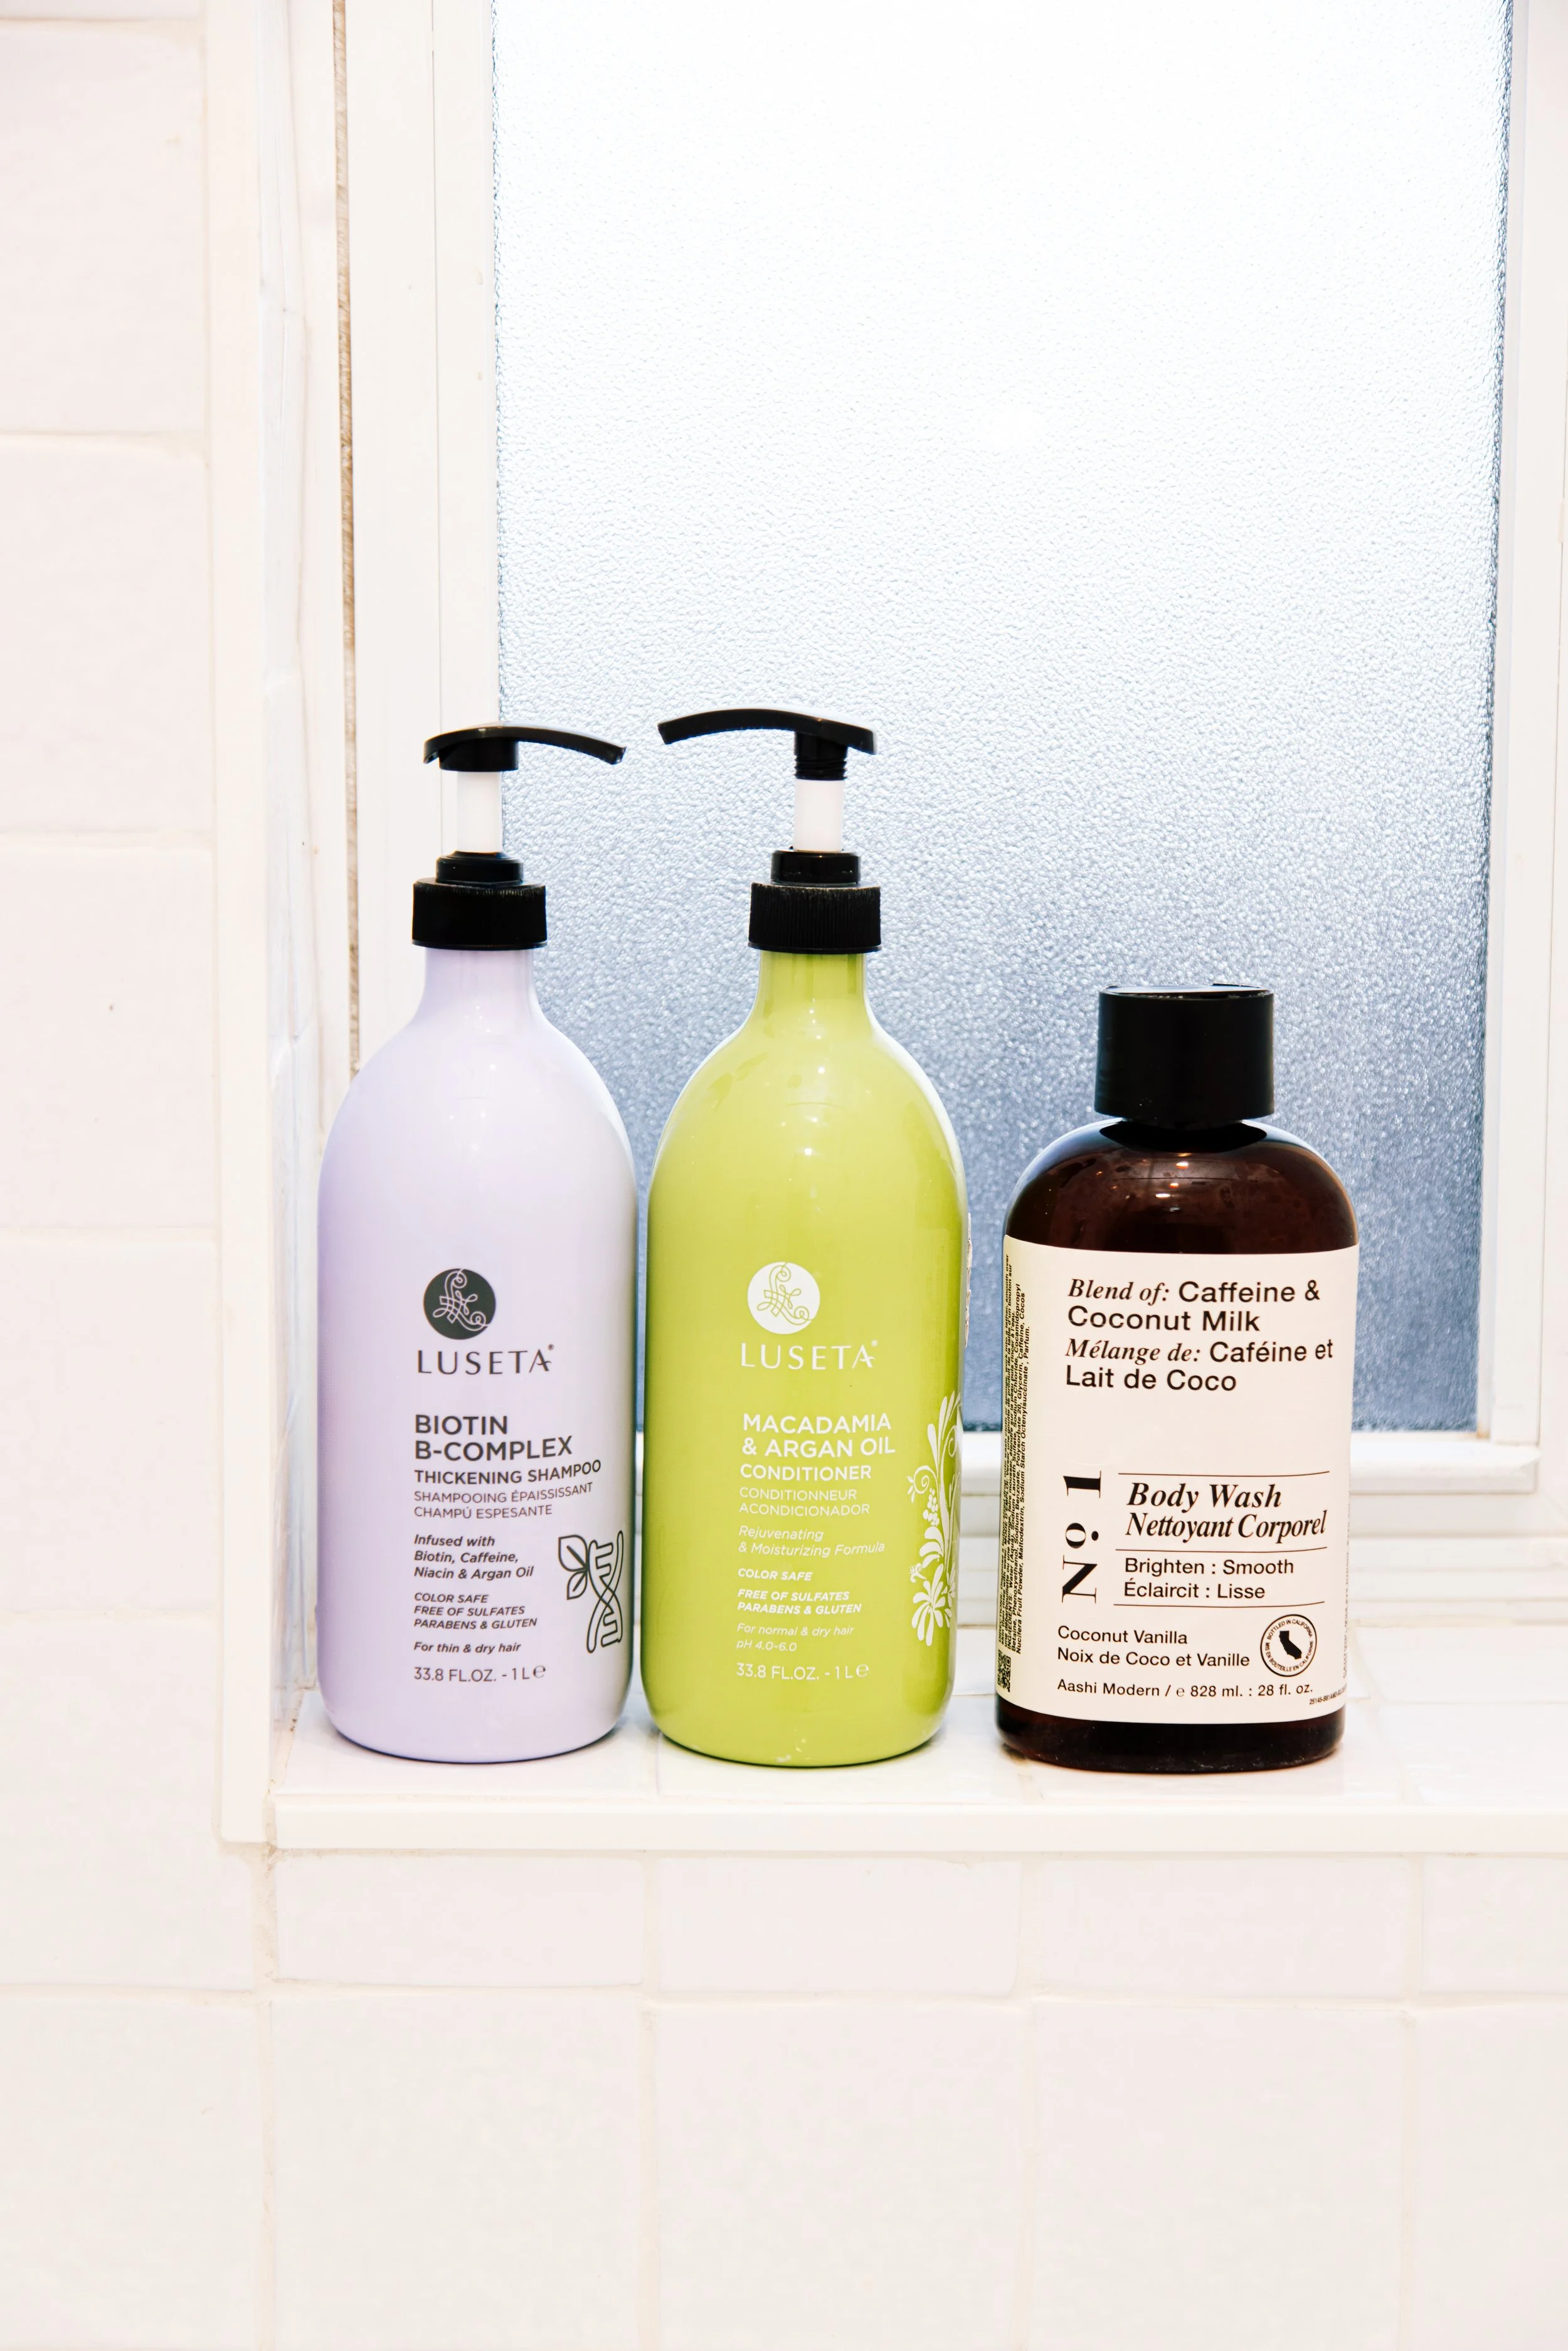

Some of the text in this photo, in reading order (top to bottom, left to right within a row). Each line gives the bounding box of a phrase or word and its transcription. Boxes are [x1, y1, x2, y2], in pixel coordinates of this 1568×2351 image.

[1067, 1278, 1320, 1306] Blend of: Caffeine &
[1068, 1305, 1260, 1332] Coconut Milk
[1065, 1338, 1333, 1366] Mélange de: Caféine et
[1066, 1364, 1237, 1391] Lait de Coco
[415, 1414, 507, 1435] BIOTIN
[743, 1413, 892, 1435] MACADAMIA
[415, 1435, 572, 1462] B-COMPLEX
[742, 1436, 896, 1458] & ARGAN OIL
[414, 1459, 601, 1485] THICKENING SHAMPOO
[739, 1463, 872, 1482] CONDITIONER
[414, 1482, 593, 1504] SHAMPOOING ÉPAISSISSANT
[739, 1487, 857, 1501] CONDITIONNEUR
[1126, 1482, 1281, 1514] Body Wash
[413, 1504, 553, 1519] CHAMPÚ ESPESANTE
[739, 1502, 870, 1517] ACONDICIONADOR
[738, 1525, 824, 1542] Rejuvenating
[1125, 1509, 1327, 1544] Nettoyant Corporel
[414, 1534, 495, 1547] Infused with
[413, 1550, 518, 1564] Biotin, Caffeine,
[738, 1541, 885, 1559] & Moisturizing Formula
[413, 1566, 534, 1581] Niacin & Argan Oil
[738, 1568, 813, 1581] COLOR SAFE
[1125, 1558, 1204, 1578] Brighten
[1222, 1559, 1294, 1575] Smooth
[414, 1592, 489, 1603] COLOR SAFE
[737, 1588, 850, 1602] FREE OF SULFATES
[1124, 1578, 1199, 1598] Éclaircit
[1217, 1583, 1265, 1599] Lisse
[413, 1605, 525, 1616] FREE OF SULFATES
[737, 1601, 862, 1615] PARABENS & GLUTEN
[413, 1618, 538, 1630] PARABENS & GLUTEN
[736, 1623, 854, 1638] For normal & dry hair
[1267, 1621, 1285, 1640] BOTTLED
[1292, 1619, 1313, 1638] CALIFORNIA
[1057, 1625, 1188, 1644] Coconut Vanilla
[413, 1642, 521, 1655] For thin & dry hair
[736, 1639, 753, 1649] pH
[1057, 1647, 1250, 1667] Noix de Coco et Vanille
[1269, 1658, 1292, 1672] BOUTEILLE
[414, 1667, 444, 1682] 33.8
[448, 1669, 496, 1682] FL.OZ.
[512, 1667, 517, 1680] 1
[736, 1662, 766, 1679] 33.8
[771, 1665, 819, 1680] FL.OZ.
[835, 1665, 840, 1679] 1
[1057, 1679, 1096, 1694] Aashi
[1103, 1682, 1160, 1696] Modern
[1165, 1683, 1171, 1696] /
[1190, 1685, 1216, 1697] 828
[1222, 1685, 1244, 1697] ml.
[1258, 1685, 1274, 1696] 28
[1279, 1684, 1291, 1696] fl.
[1296, 1685, 1313, 1694] oz.
